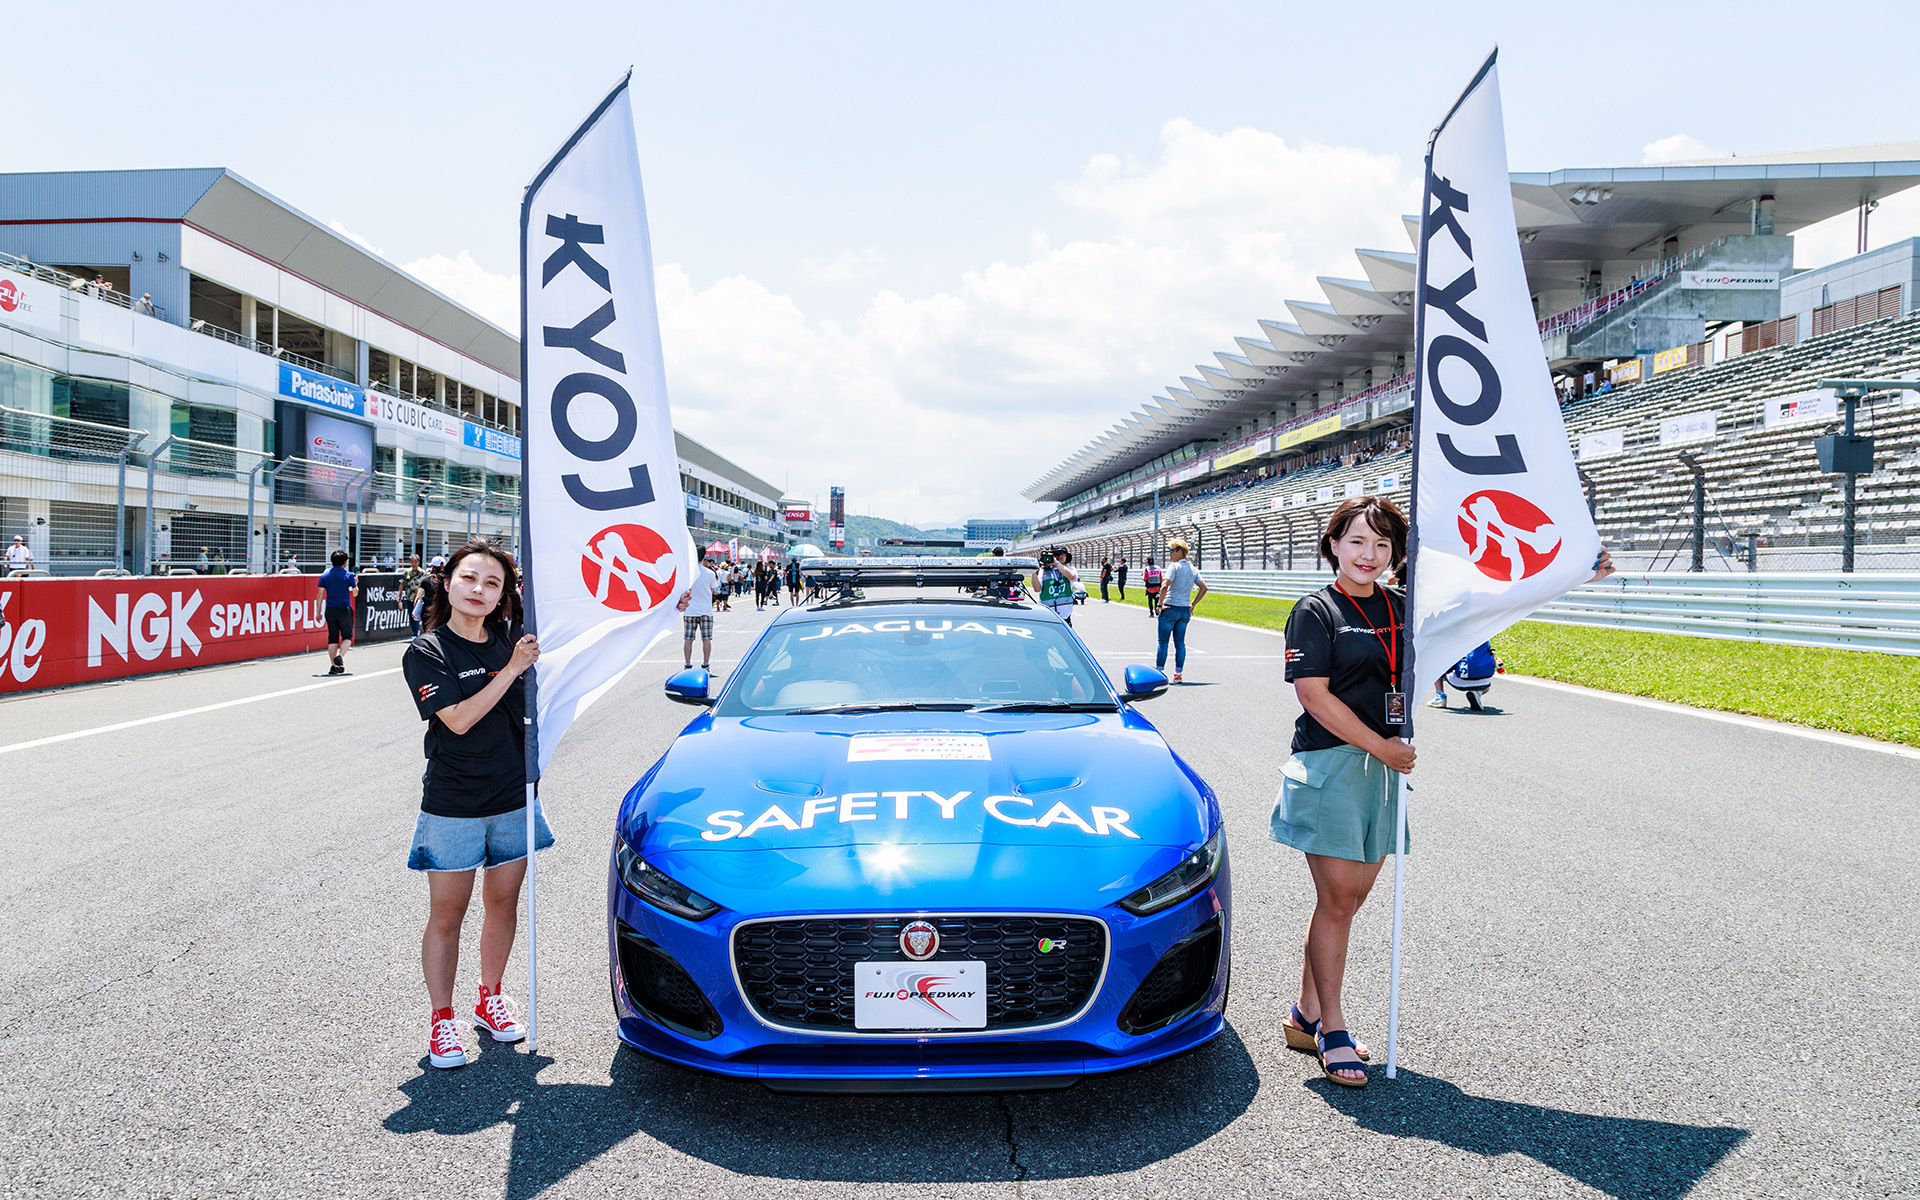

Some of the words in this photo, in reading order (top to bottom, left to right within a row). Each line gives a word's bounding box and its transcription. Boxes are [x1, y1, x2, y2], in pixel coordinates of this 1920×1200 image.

[291, 370, 355, 410] Panasonic
[381, 398, 394, 420] TS
[396, 403, 427, 430] CUBIC
[428, 416, 443, 431] CARD
[366, 586, 385, 603] NGK
[1049, 583, 1066, 595] 07
[87, 588, 204, 668] NGK
[209, 600, 285, 638] SPARK
[290, 599, 327, 631] PLU
[799, 620, 1036, 642] JAGUAR
[700, 791, 974, 842] SAFETY
[983, 795, 1144, 840] CAR
[864, 990, 896, 999] FUJI
[896, 989, 976, 1001] SPEEDWAY
